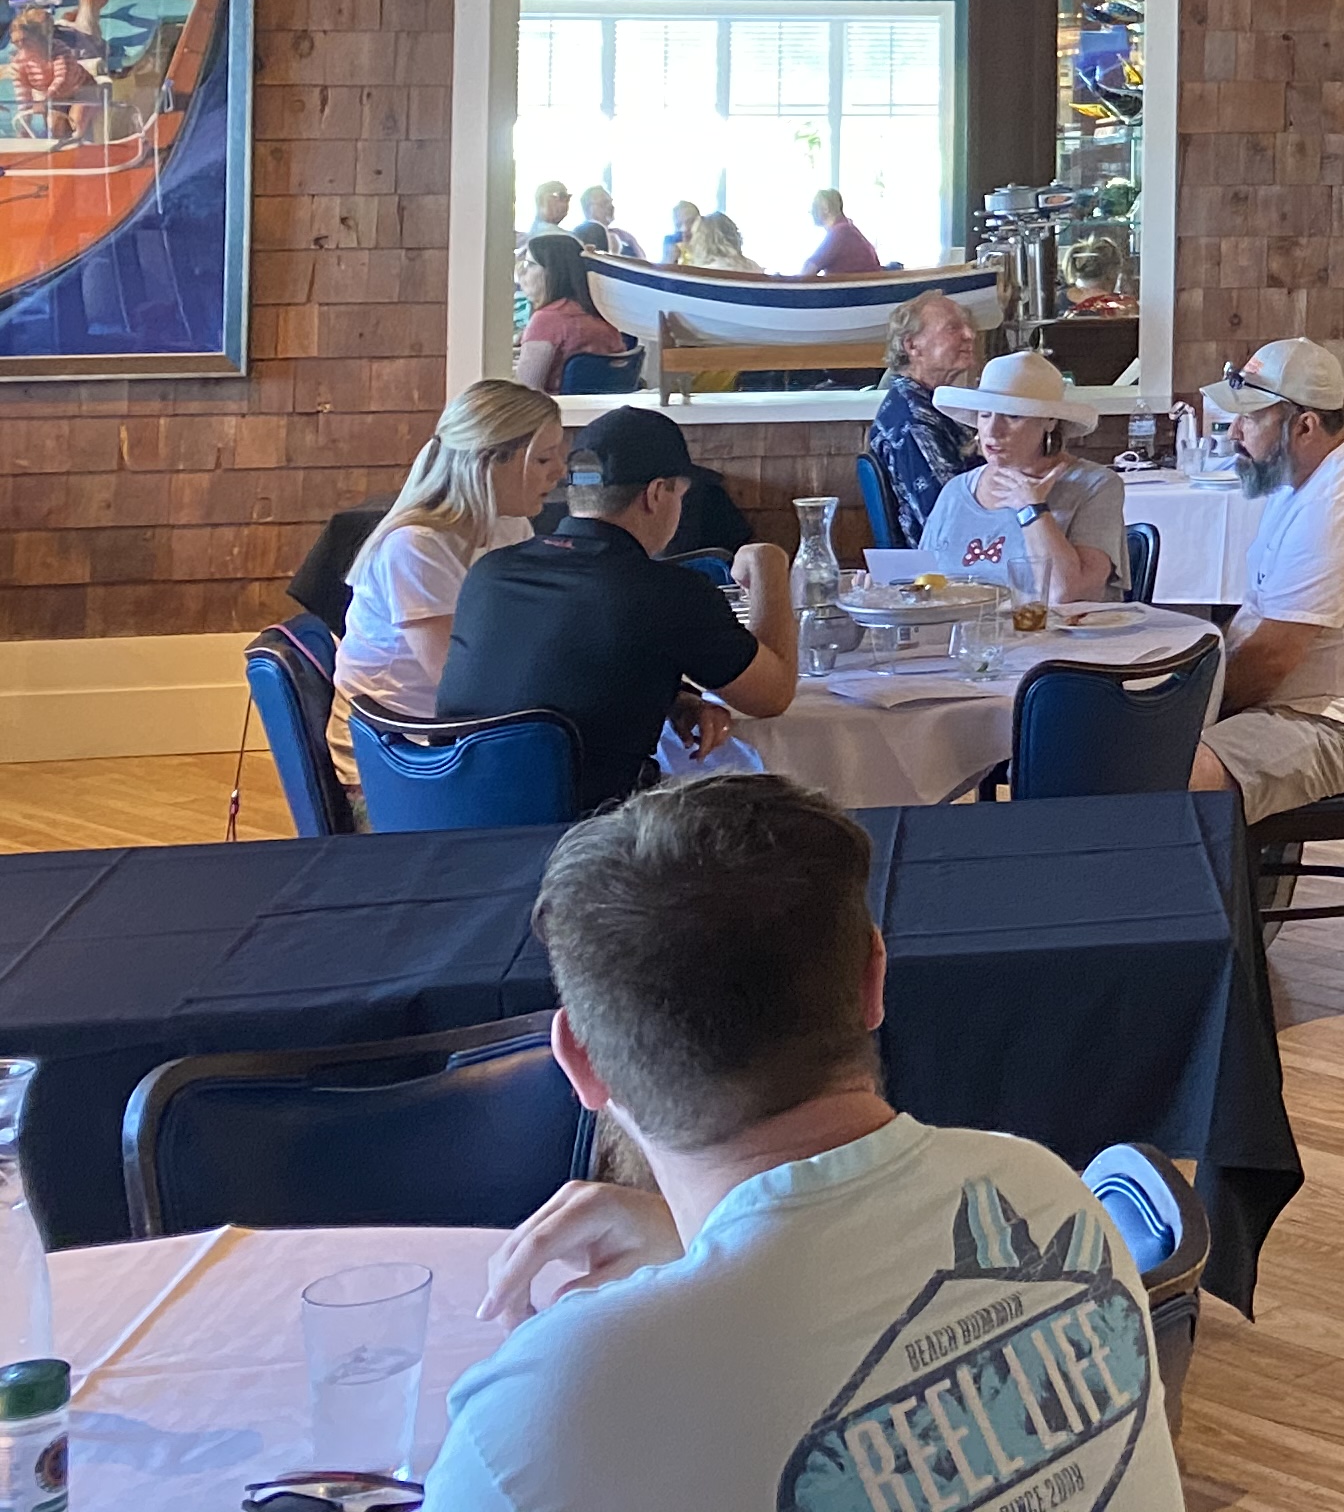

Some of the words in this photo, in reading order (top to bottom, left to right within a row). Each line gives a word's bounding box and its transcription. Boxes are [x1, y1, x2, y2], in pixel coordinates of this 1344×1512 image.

[844, 1363, 1024, 1512] REEL
[1002, 1299, 1131, 1451] LIFE
[905, 1325, 958, 1372] BEACH
